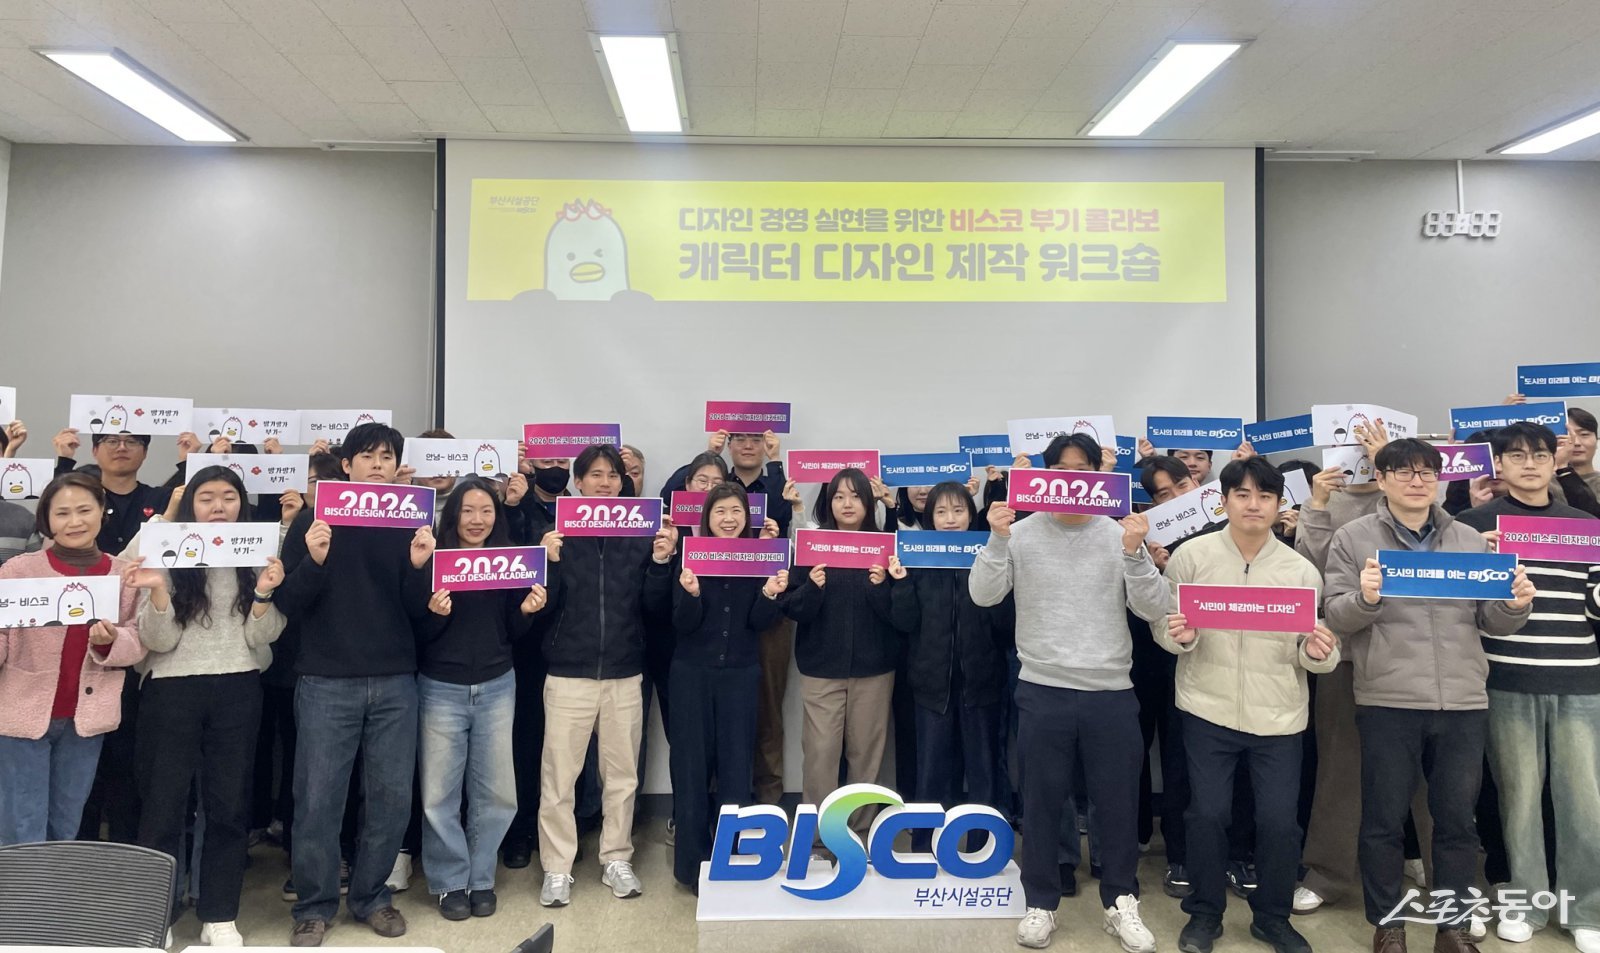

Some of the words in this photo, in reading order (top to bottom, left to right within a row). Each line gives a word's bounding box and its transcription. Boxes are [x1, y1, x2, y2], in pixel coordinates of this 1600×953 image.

[678, 207, 754, 232] 디자인
[760, 207, 809, 232] 경영
[814, 207, 889, 232] 실현을
[894, 207, 945, 232] 위한
[950, 208, 1024, 232] 비스코
[1030, 208, 1080, 232] 부기
[1085, 208, 1160, 232] 콜라보
[678, 242, 801, 281] 캐릭터
[814, 242, 935, 281] 디자인
[946, 242, 1030, 281] 제작
[1038, 242, 1161, 281] 워크숍
[150, 409, 179, 417] 방가방가
[263, 420, 288, 428] 방가방가
[448, 453, 469, 461] 비스코
[268, 467, 296, 475] 방가방가
[1441, 464, 1485, 474] ACADEMY
[1029, 478, 1110, 498] 2026
[339, 490, 418, 511] 2026
[1016, 494, 1043, 503] BISCO
[1044, 495, 1075, 506] DESIGN
[1076, 496, 1122, 508] ACADEMY
[324, 507, 351, 516] BISCO
[352, 508, 386, 518] DESIGN
[387, 510, 428, 520] ACADEMY
[576, 504, 645, 522] 2026
[1156, 518, 1175, 530] 안녕~
[1175, 507, 1197, 521] 비스코
[564, 520, 587, 529] BISCO
[588, 520, 616, 529] DESIGN
[617, 520, 655, 529] ACADEMY
[230, 537, 264, 546] 방가방가
[1504, 532, 1529, 542] 2026
[1530, 533, 1559, 544] 비스코
[1560, 534, 1590, 546] 디자인
[925, 544, 946, 552] 미래를
[948, 544, 962, 552] 여는
[688, 552, 708, 560] 2026
[708, 552, 730, 560] 비스코
[454, 556, 527, 576] 2026
[442, 574, 466, 584] BISCO
[468, 572, 498, 582] DESIGN
[499, 570, 538, 580] ACADEMY
[1416, 569, 1445, 579] 미래를
[1446, 570, 1466, 580] 여는
[20, 596, 49, 607] 비스코
[1228, 602, 1265, 613] 체감하는
[708, 783, 1015, 901] BISCO
[913, 887, 1013, 908] 부산시설공단
